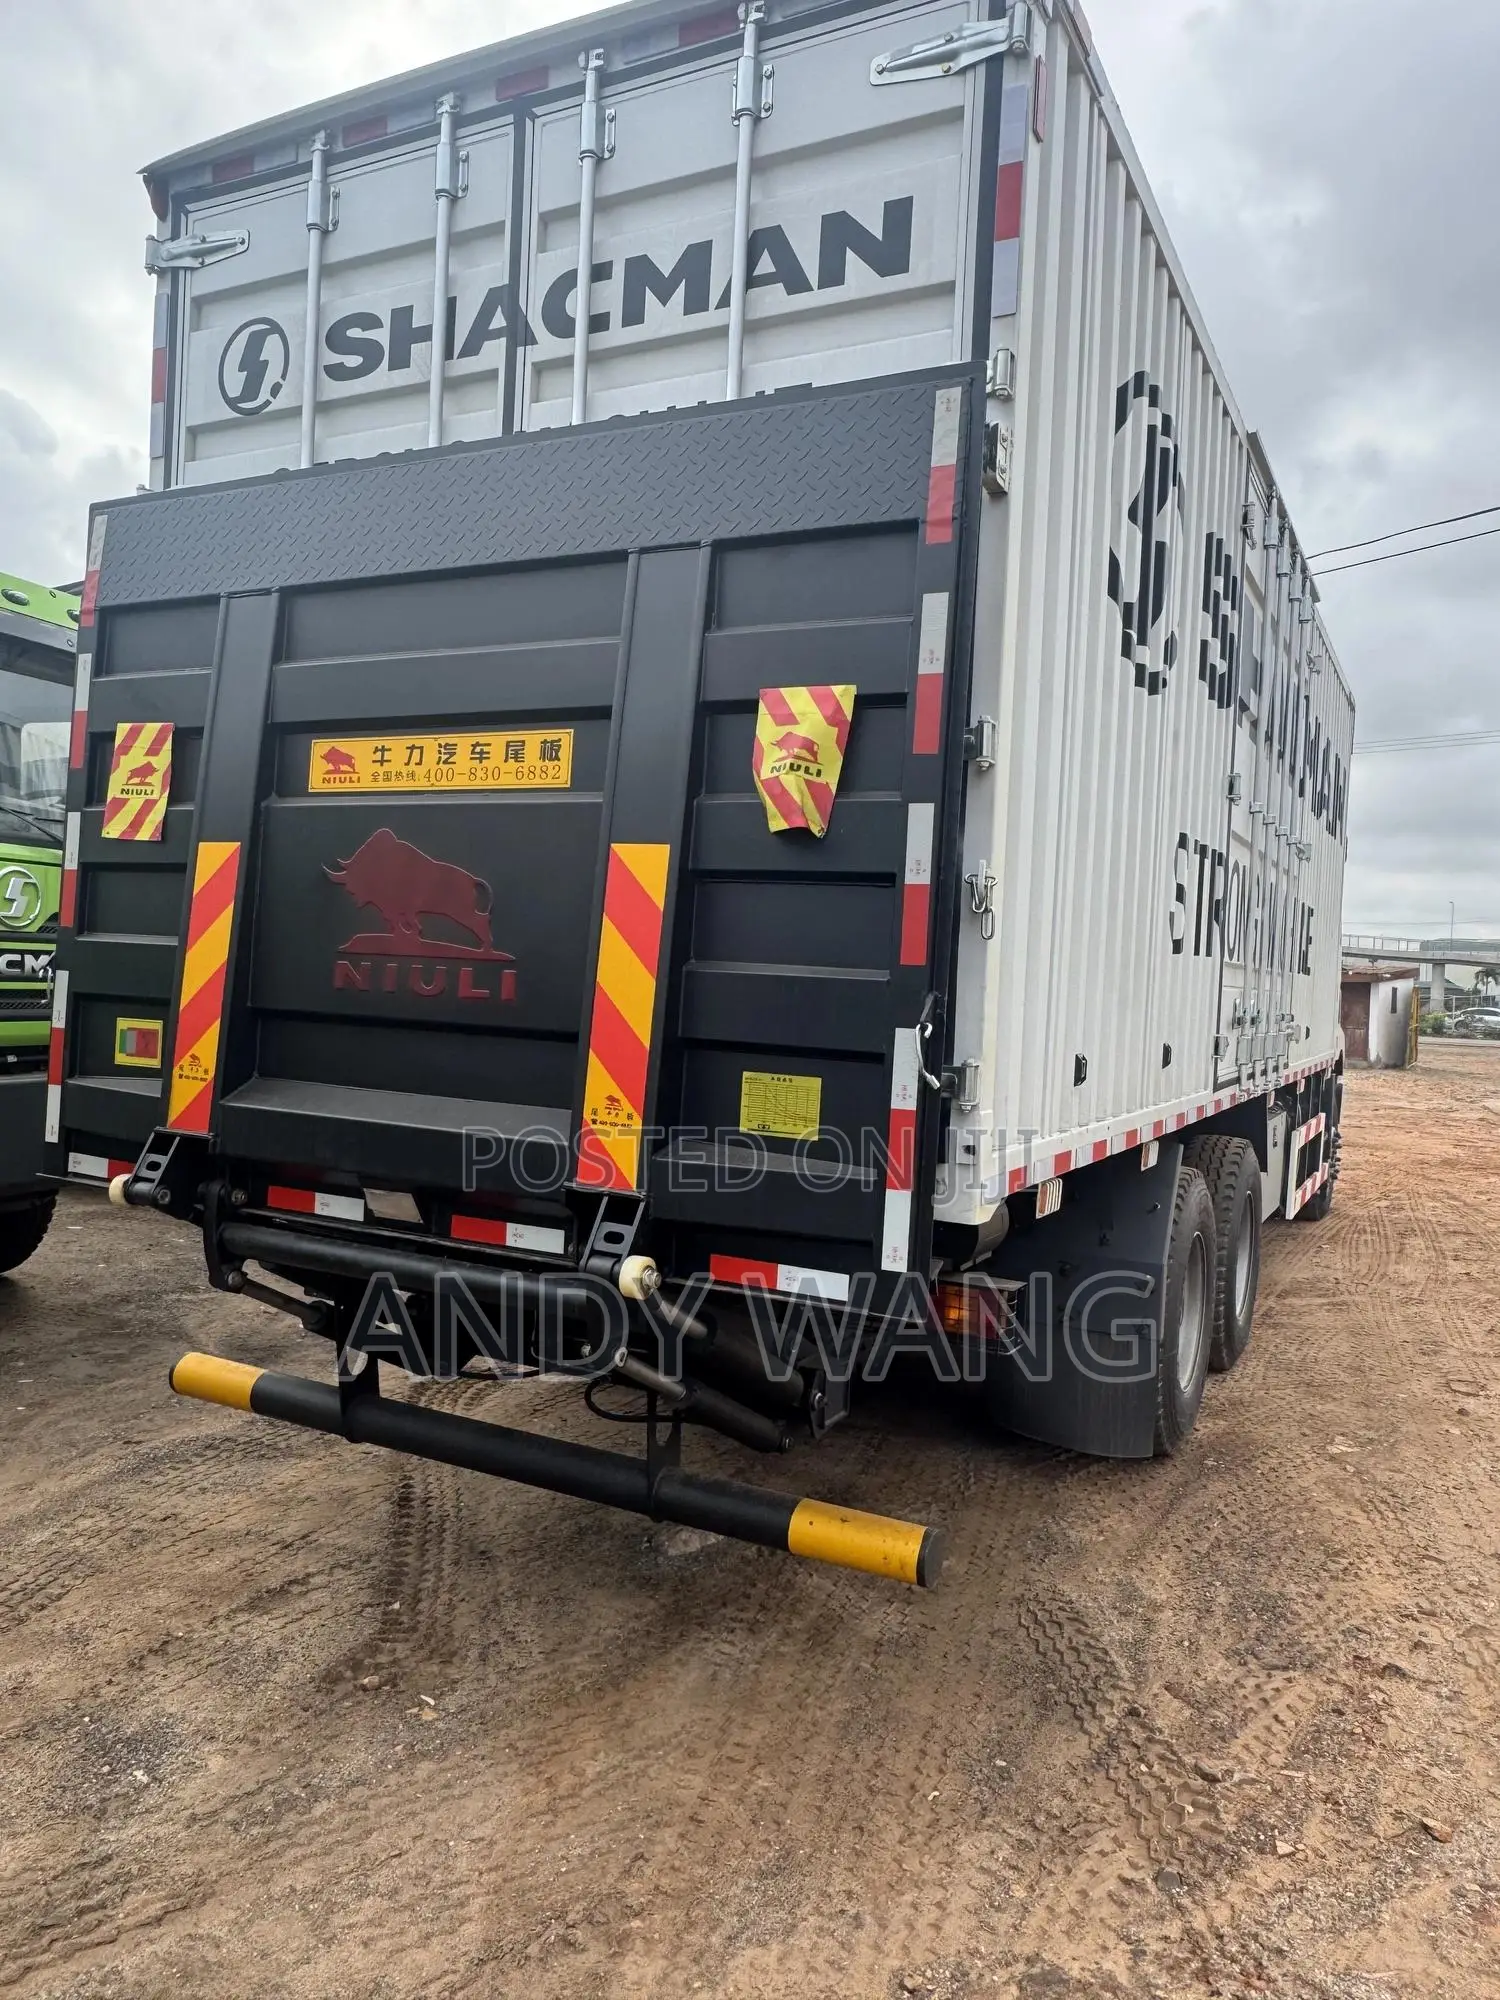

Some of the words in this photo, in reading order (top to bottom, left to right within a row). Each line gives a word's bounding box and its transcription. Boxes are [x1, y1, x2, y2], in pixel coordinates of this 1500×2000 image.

[322, 195, 915, 382] SHACMAN
[371, 738, 562, 767] 牛力汽车尾板
[120, 787, 155, 796] NIULI
[321, 775, 361, 784] NIULI
[333, 960, 518, 1001] NIULI
